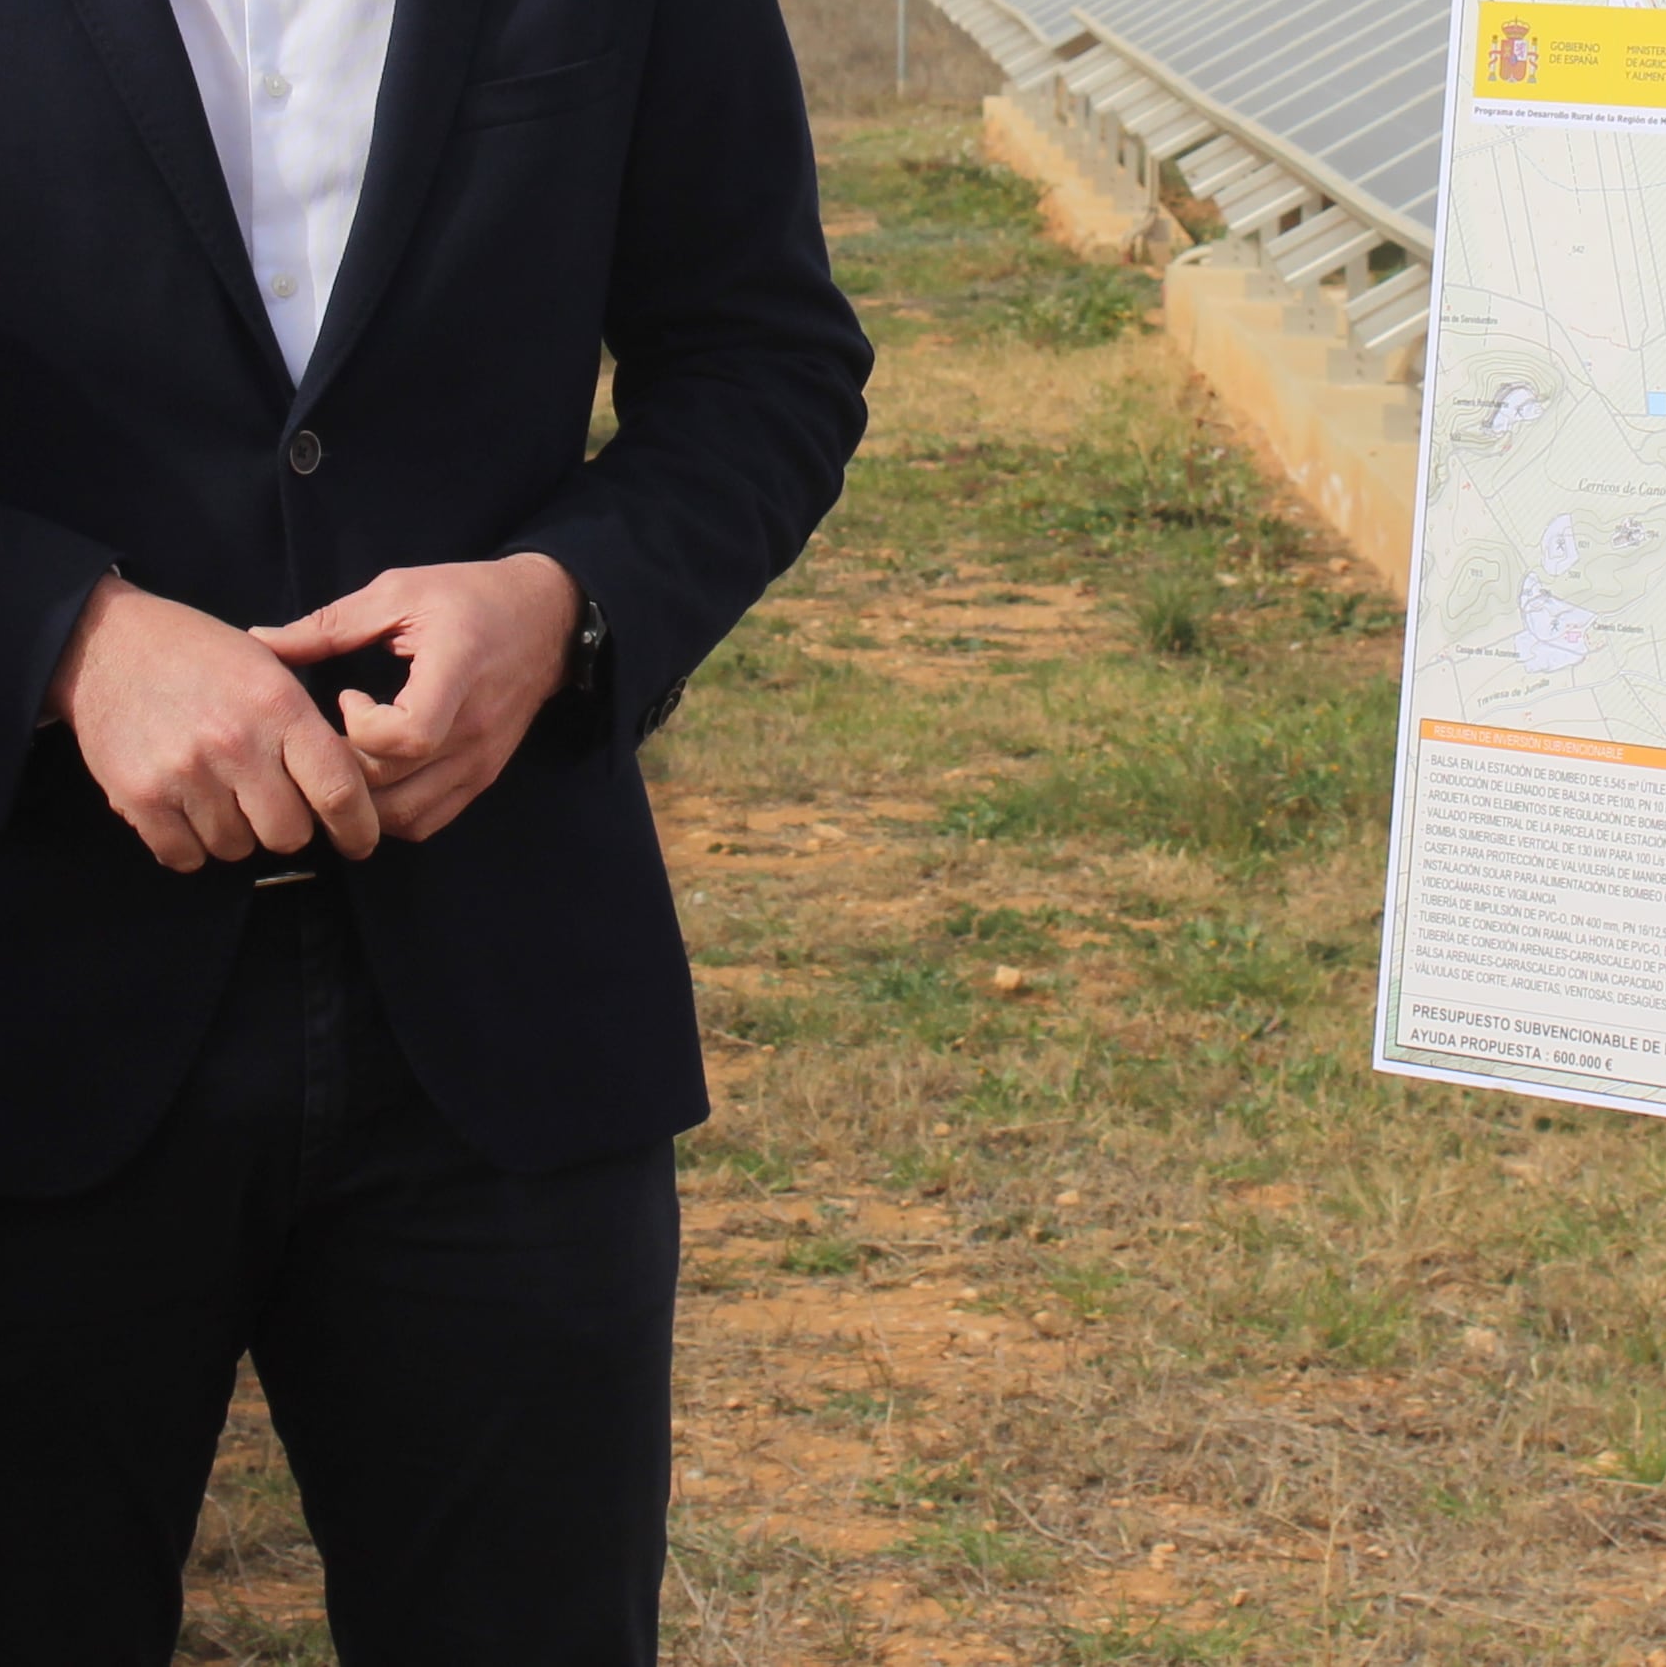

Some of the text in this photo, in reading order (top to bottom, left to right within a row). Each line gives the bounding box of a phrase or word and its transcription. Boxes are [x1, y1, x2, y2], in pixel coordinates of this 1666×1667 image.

[1549, 41, 1601, 53] GOBIERNO
[1549, 53, 1599, 65] DE ESPAÑA
[1625, 58, 1639, 68] DE
[1625, 71, 1631, 80] Y
[1474, 106, 1513, 119] Programa
[1515, 108, 1526, 117] de
[1527, 109, 1569, 121] Desarrollo
[1571, 111, 1593, 121] Rural
[1595, 112, 1605, 122] de
[1607, 113, 1615, 122] la
[1617, 113, 1646, 125] Región
[1648, 116, 1658, 125] de
[1578, 478, 1666, 497] Cerricos de Cano
[1434, 725, 1624, 760] RESUMEN DE INVERSIÓN SUBVENCIONABLE
[1431, 754, 1459, 769] BALSA
[1461, 758, 1474, 770] EN
[1475, 760, 1486, 772] LA
[1487, 761, 1532, 778] ESTACIÓN
[1534, 768, 1547, 780] DE
[1548, 769, 1587, 785] BOMBEO
[1589, 775, 1602, 787] DE
[1603, 776, 1626, 790] 5.545
[1428, 790, 1470, 804] ARQUETA
[1472, 795, 1491, 808] CON
[1493, 797, 1547, 815] ELEMENTOS
[1548, 804, 1561, 816] DE
[1563, 805, 1622, 826] REGULACIÓN
[1624, 813, 1637, 826] DE
[1421, 875, 1557, 905] VIDEOCÁMARAS DE VIGILANCIA
[1412, 1003, 1511, 1031] PRESUPUESTO
[1514, 1020, 1638, 1051] SUBVENCIONABLE
[1642, 1038, 1661, 1054] DE
[1410, 1027, 1456, 1046] AYUDA
[1460, 1035, 1541, 1061] PROPUESTA
[1553, 1051, 1601, 1070] 600.000
[1604, 1057, 1613, 1071] €
